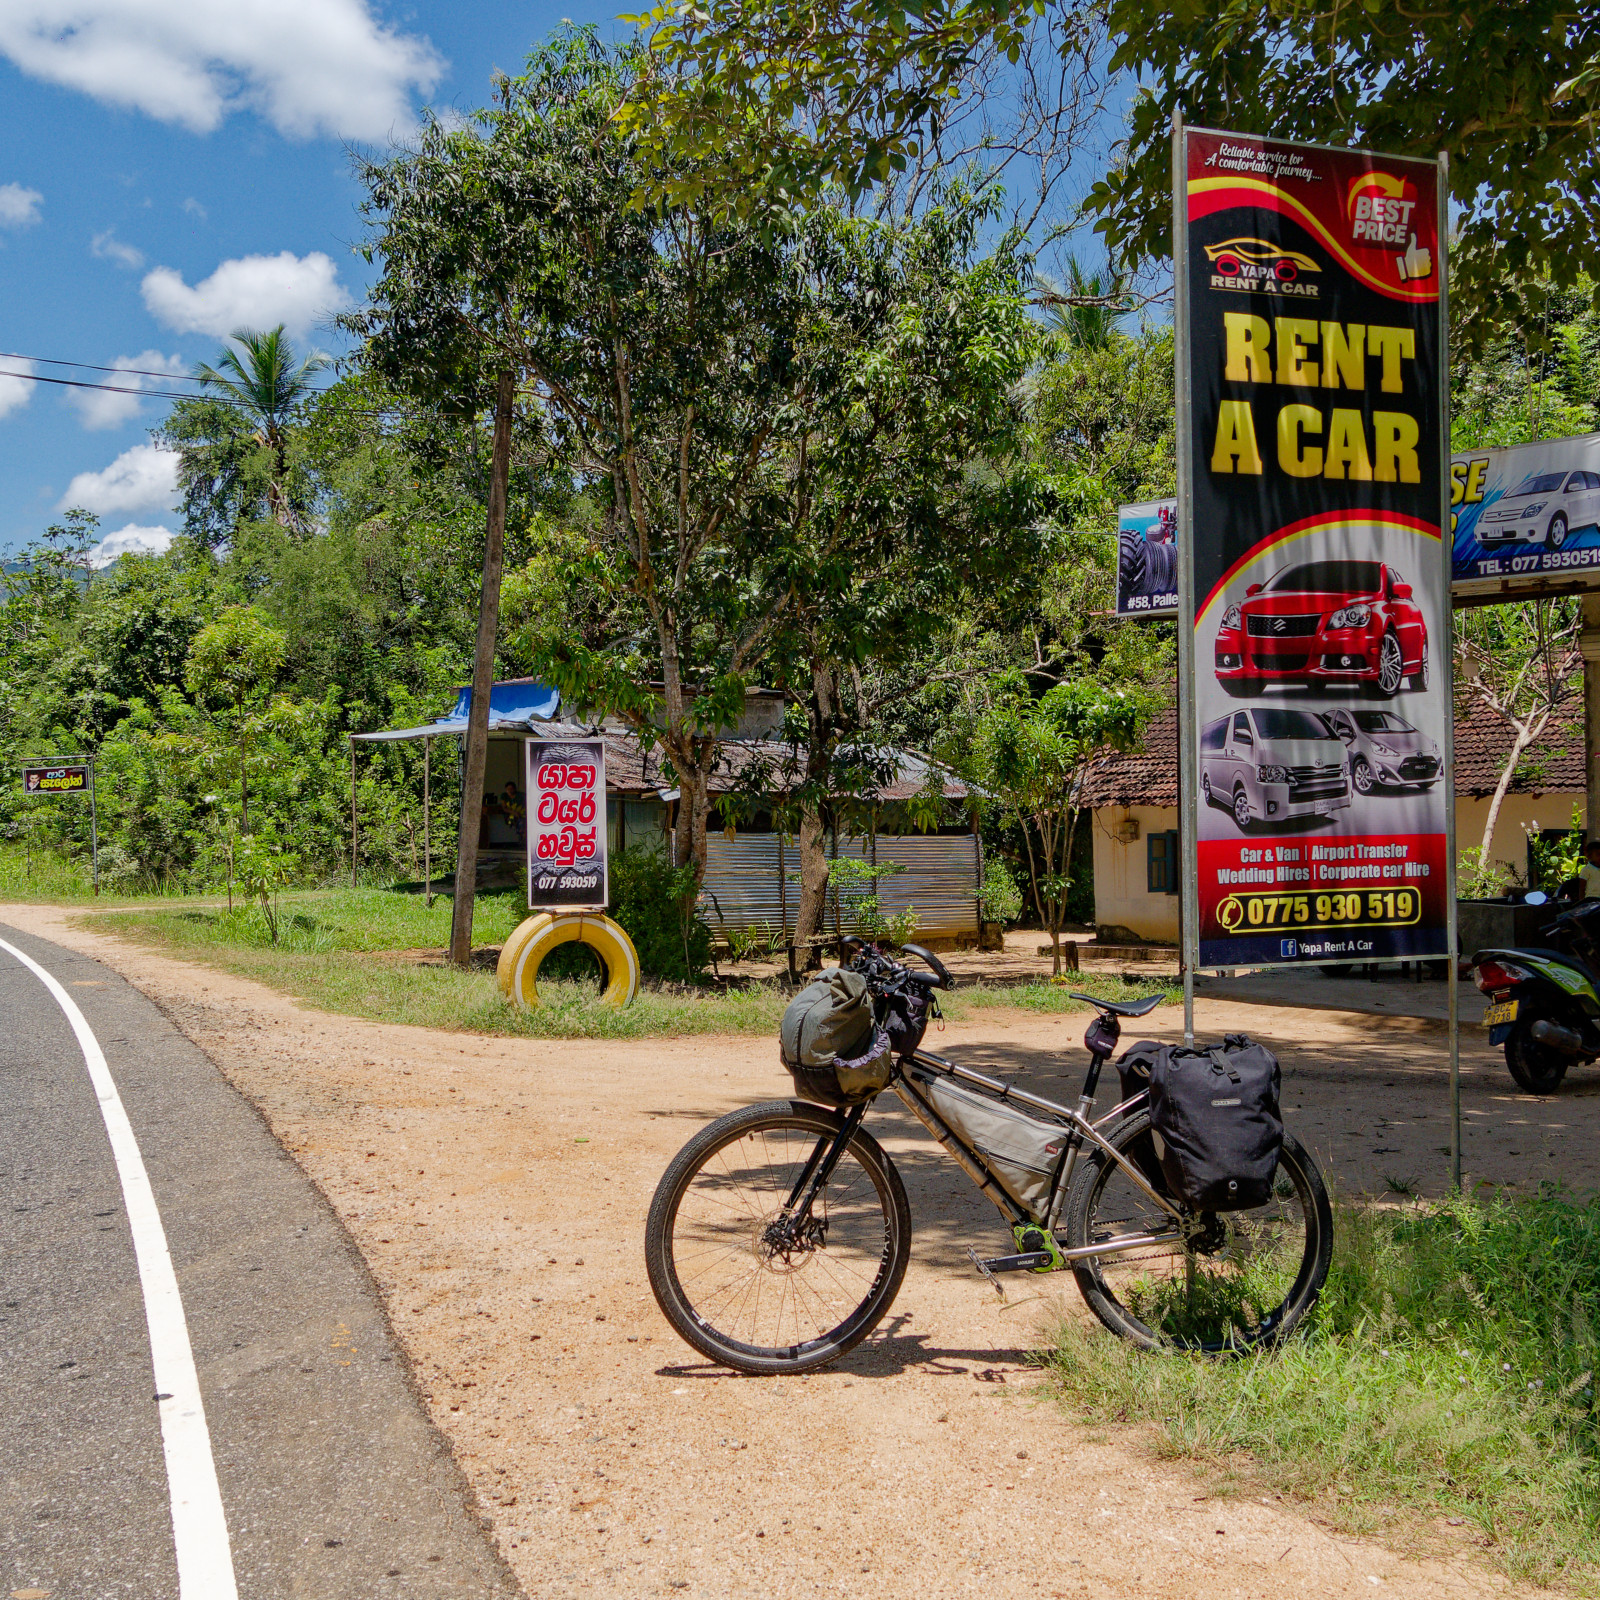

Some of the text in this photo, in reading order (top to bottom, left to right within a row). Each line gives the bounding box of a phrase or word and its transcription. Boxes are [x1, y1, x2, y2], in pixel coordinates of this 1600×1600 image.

[1204, 152, 1218, 166] A
[1218, 157, 1274, 174] comfortable
[1219, 142, 1304, 165] Reliable service for
[1354, 195, 1416, 225] BEST
[1352, 219, 1407, 244] PRICE
[1240, 264, 1276, 280] YAPA
[1210, 275, 1319, 296] RENT A CAR
[1223, 311, 1415, 394] RENT
[1211, 400, 1421, 484] A CAR
[1512, 555, 1539, 572] 077
[1542, 548, 1600, 568] 593051
[537, 764, 597, 789] යාපා
[537, 791, 597, 824] ටයර්
[537, 825, 597, 866] හවුස්
[1240, 843, 1408, 863] Car & Van Airport Transfer
[538, 876, 598, 890] 077 5930519
[1217, 862, 1430, 885] Wedding Hires Corporate car Hire
[1248, 892, 1412, 925] 0775 930 519
[1299, 942, 1322, 956] Yapa
[1324, 941, 1346, 952] Rent
[1348, 940, 1355, 952] A
[1357, 940, 1373, 951] Car
